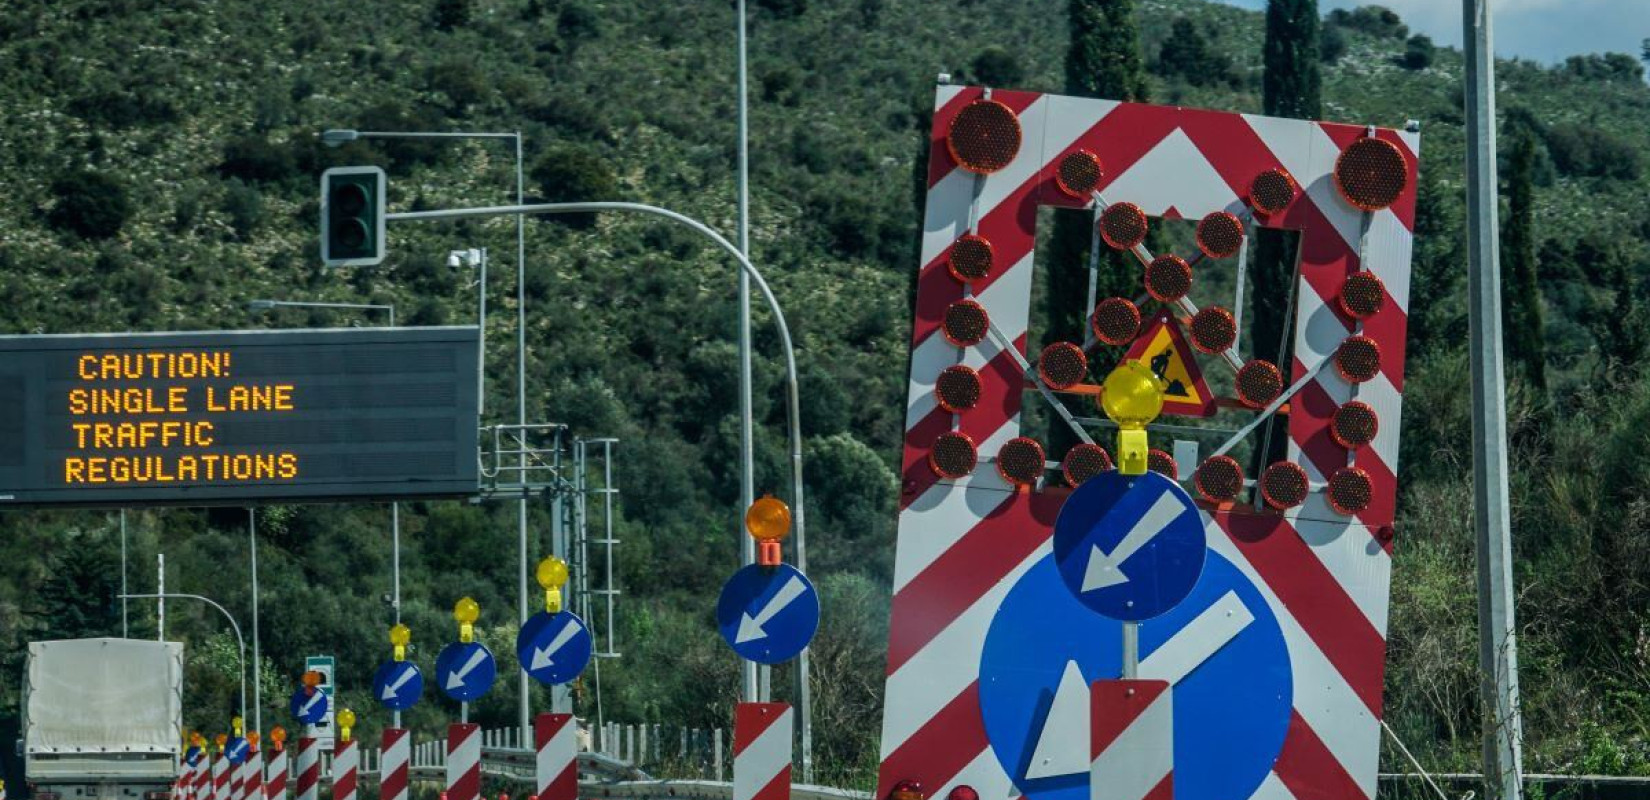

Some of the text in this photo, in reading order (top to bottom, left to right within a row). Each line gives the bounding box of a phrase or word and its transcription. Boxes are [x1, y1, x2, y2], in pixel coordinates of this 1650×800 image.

[78, 352, 230, 380] CAUTION!
[69, 385, 294, 414] SINGLE LANE
[72, 421, 214, 448] TRAFFIC
[65, 454, 298, 482] REGULATIONS
